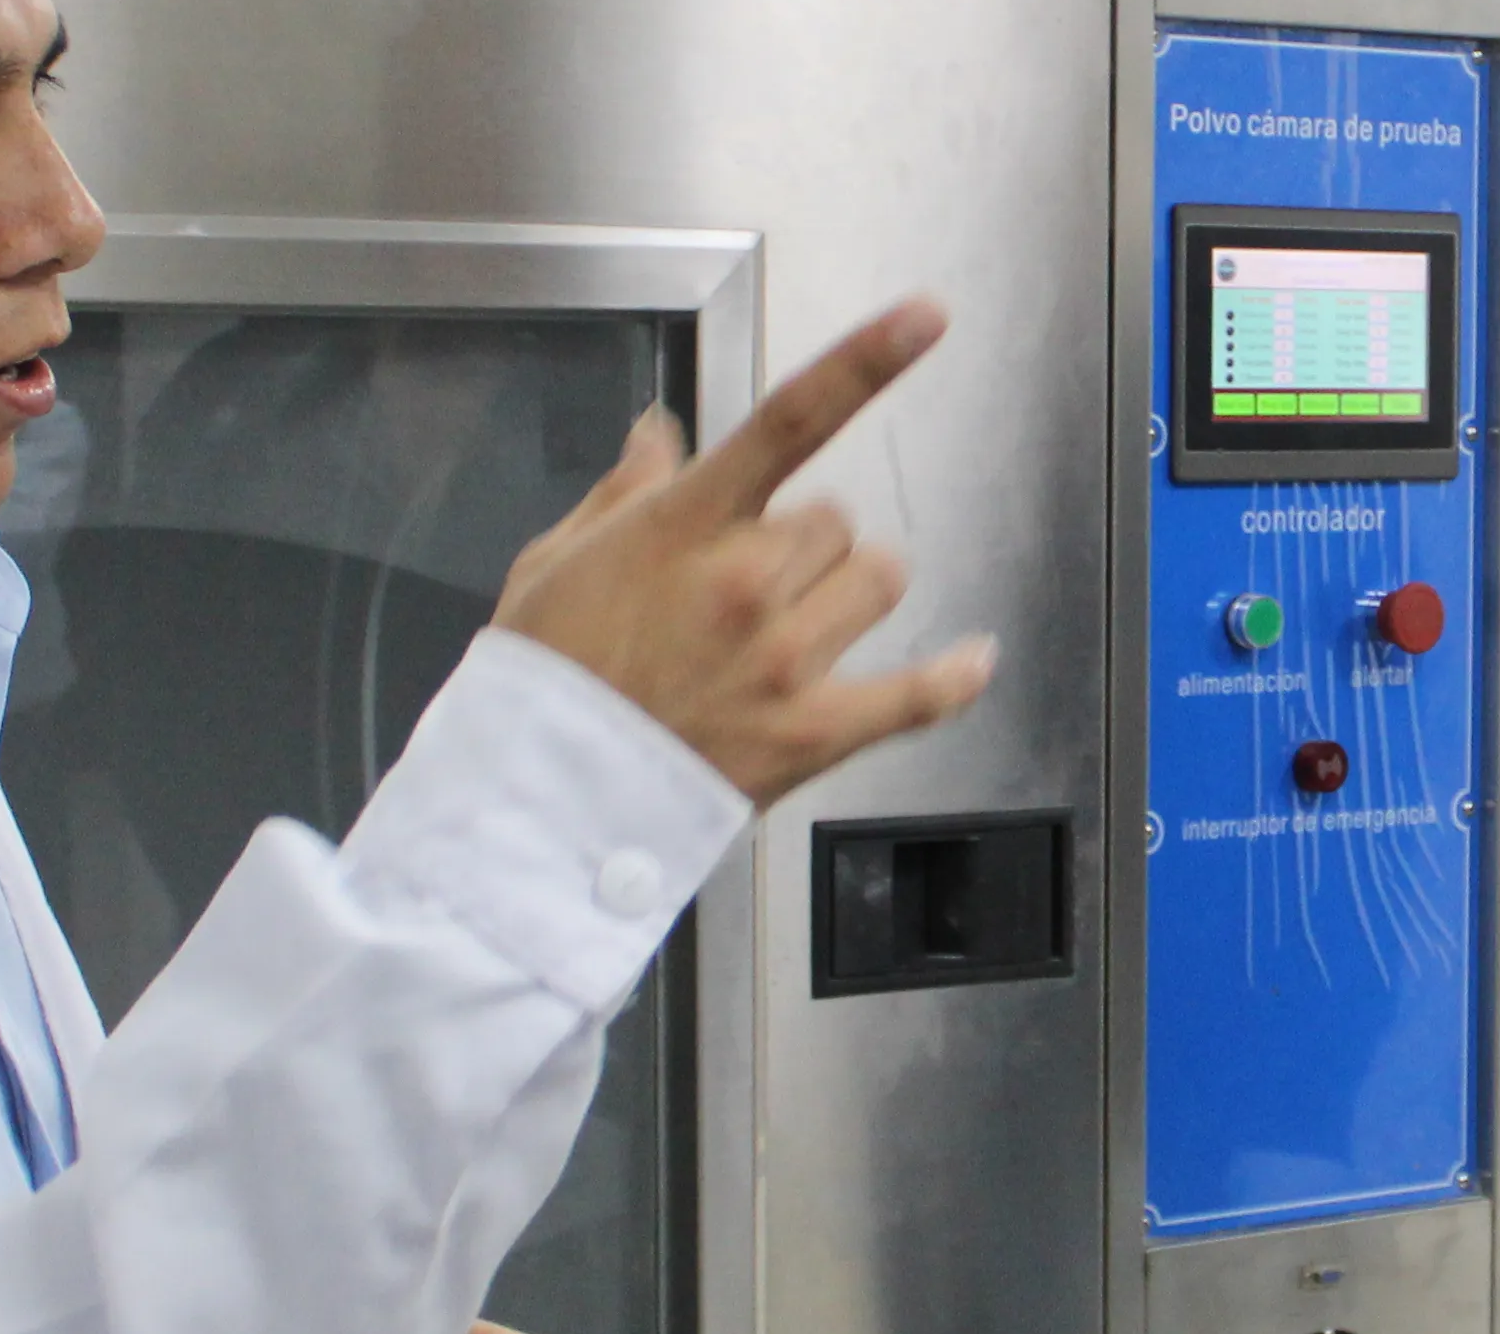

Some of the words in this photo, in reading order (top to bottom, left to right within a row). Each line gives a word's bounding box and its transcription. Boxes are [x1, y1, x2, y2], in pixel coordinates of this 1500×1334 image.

[1170, 103, 1242, 135] Polvo
[1247, 109, 1338, 140] cámara
[1343, 113, 1374, 142] de
[1379, 118, 1463, 149] prueba
[1241, 504, 1386, 534] controlador
[1181, 815, 1289, 841] interruptor
[1292, 812, 1317, 834] de
[1321, 803, 1438, 834] emergencia
